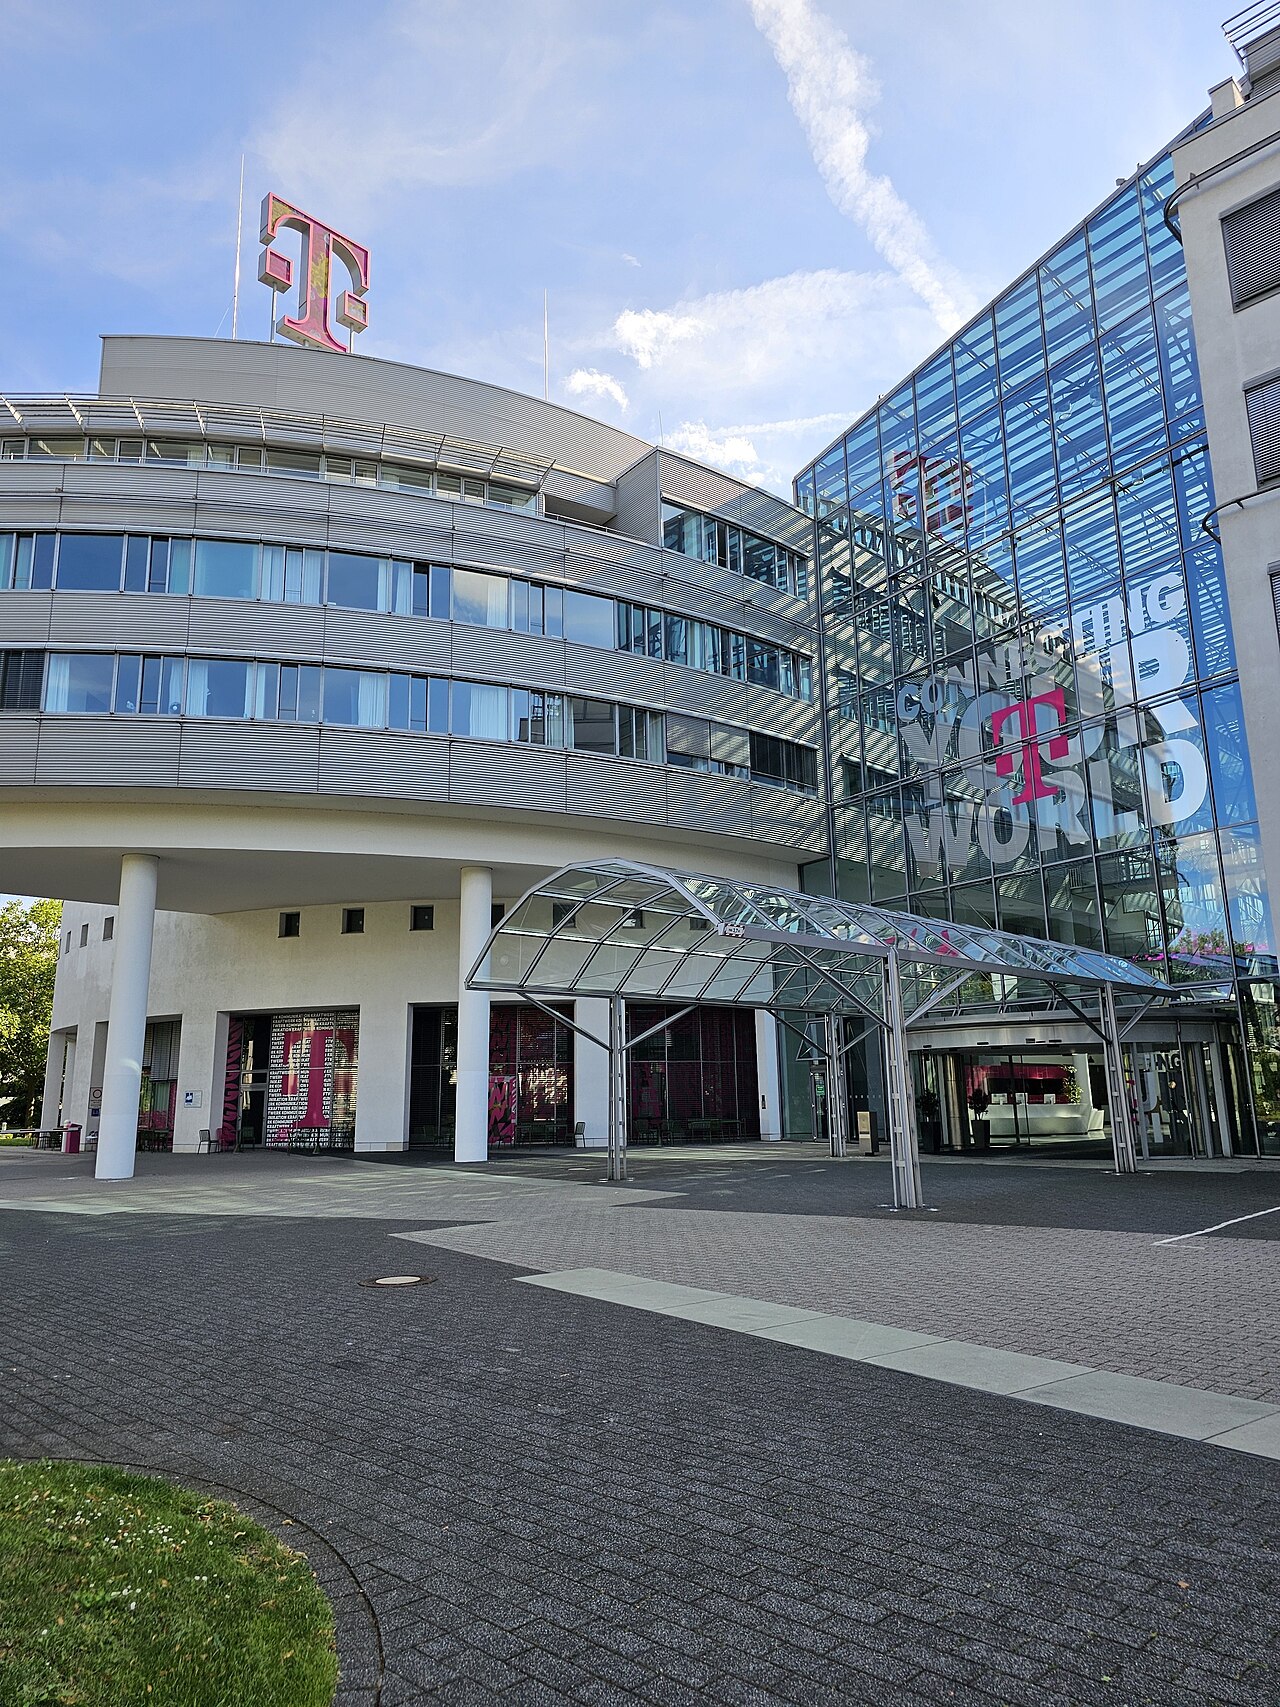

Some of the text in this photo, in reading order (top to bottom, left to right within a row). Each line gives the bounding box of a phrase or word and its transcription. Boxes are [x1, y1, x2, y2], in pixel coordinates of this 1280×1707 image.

[258, 192, 371, 353] T
[897, 573, 1186, 723] CONNECTING
[900, 628, 1199, 807] YOUR
[904, 738, 1208, 878] WORLD
[991, 687, 1069, 806] T
